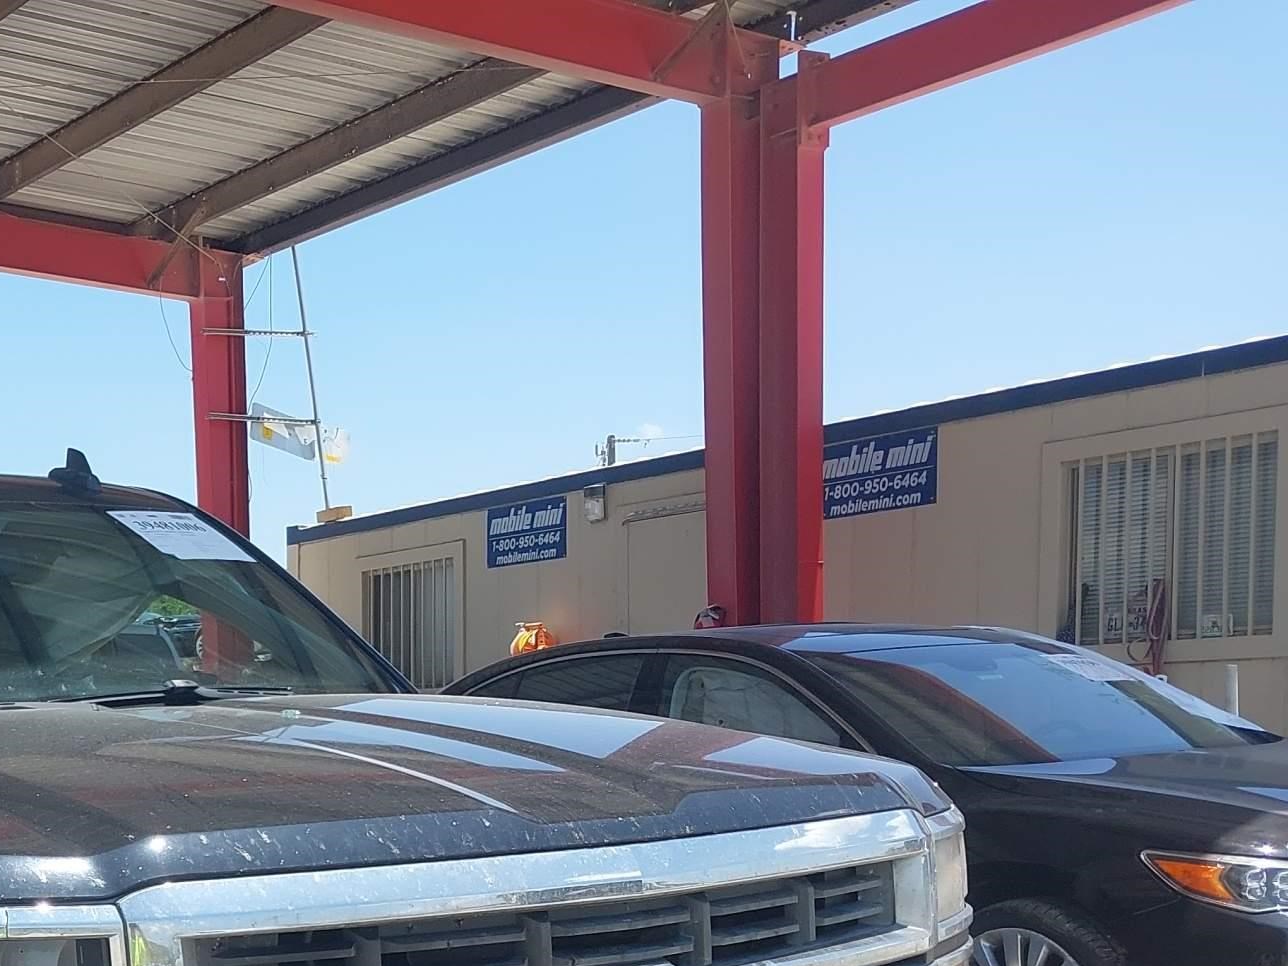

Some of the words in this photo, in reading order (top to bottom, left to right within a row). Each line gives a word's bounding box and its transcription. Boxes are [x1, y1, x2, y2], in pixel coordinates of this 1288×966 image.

[823, 441, 884, 479] mobile
[885, 435, 933, 469] mini
[824, 470, 928, 501] 1-800-950-6464
[830, 492, 922, 516] mobilemini.com
[489, 505, 533, 536] mobile
[532, 502, 565, 529] mini
[492, 531, 561, 553] 1-800-950-6464
[495, 548, 557, 565] mobilemini.com
